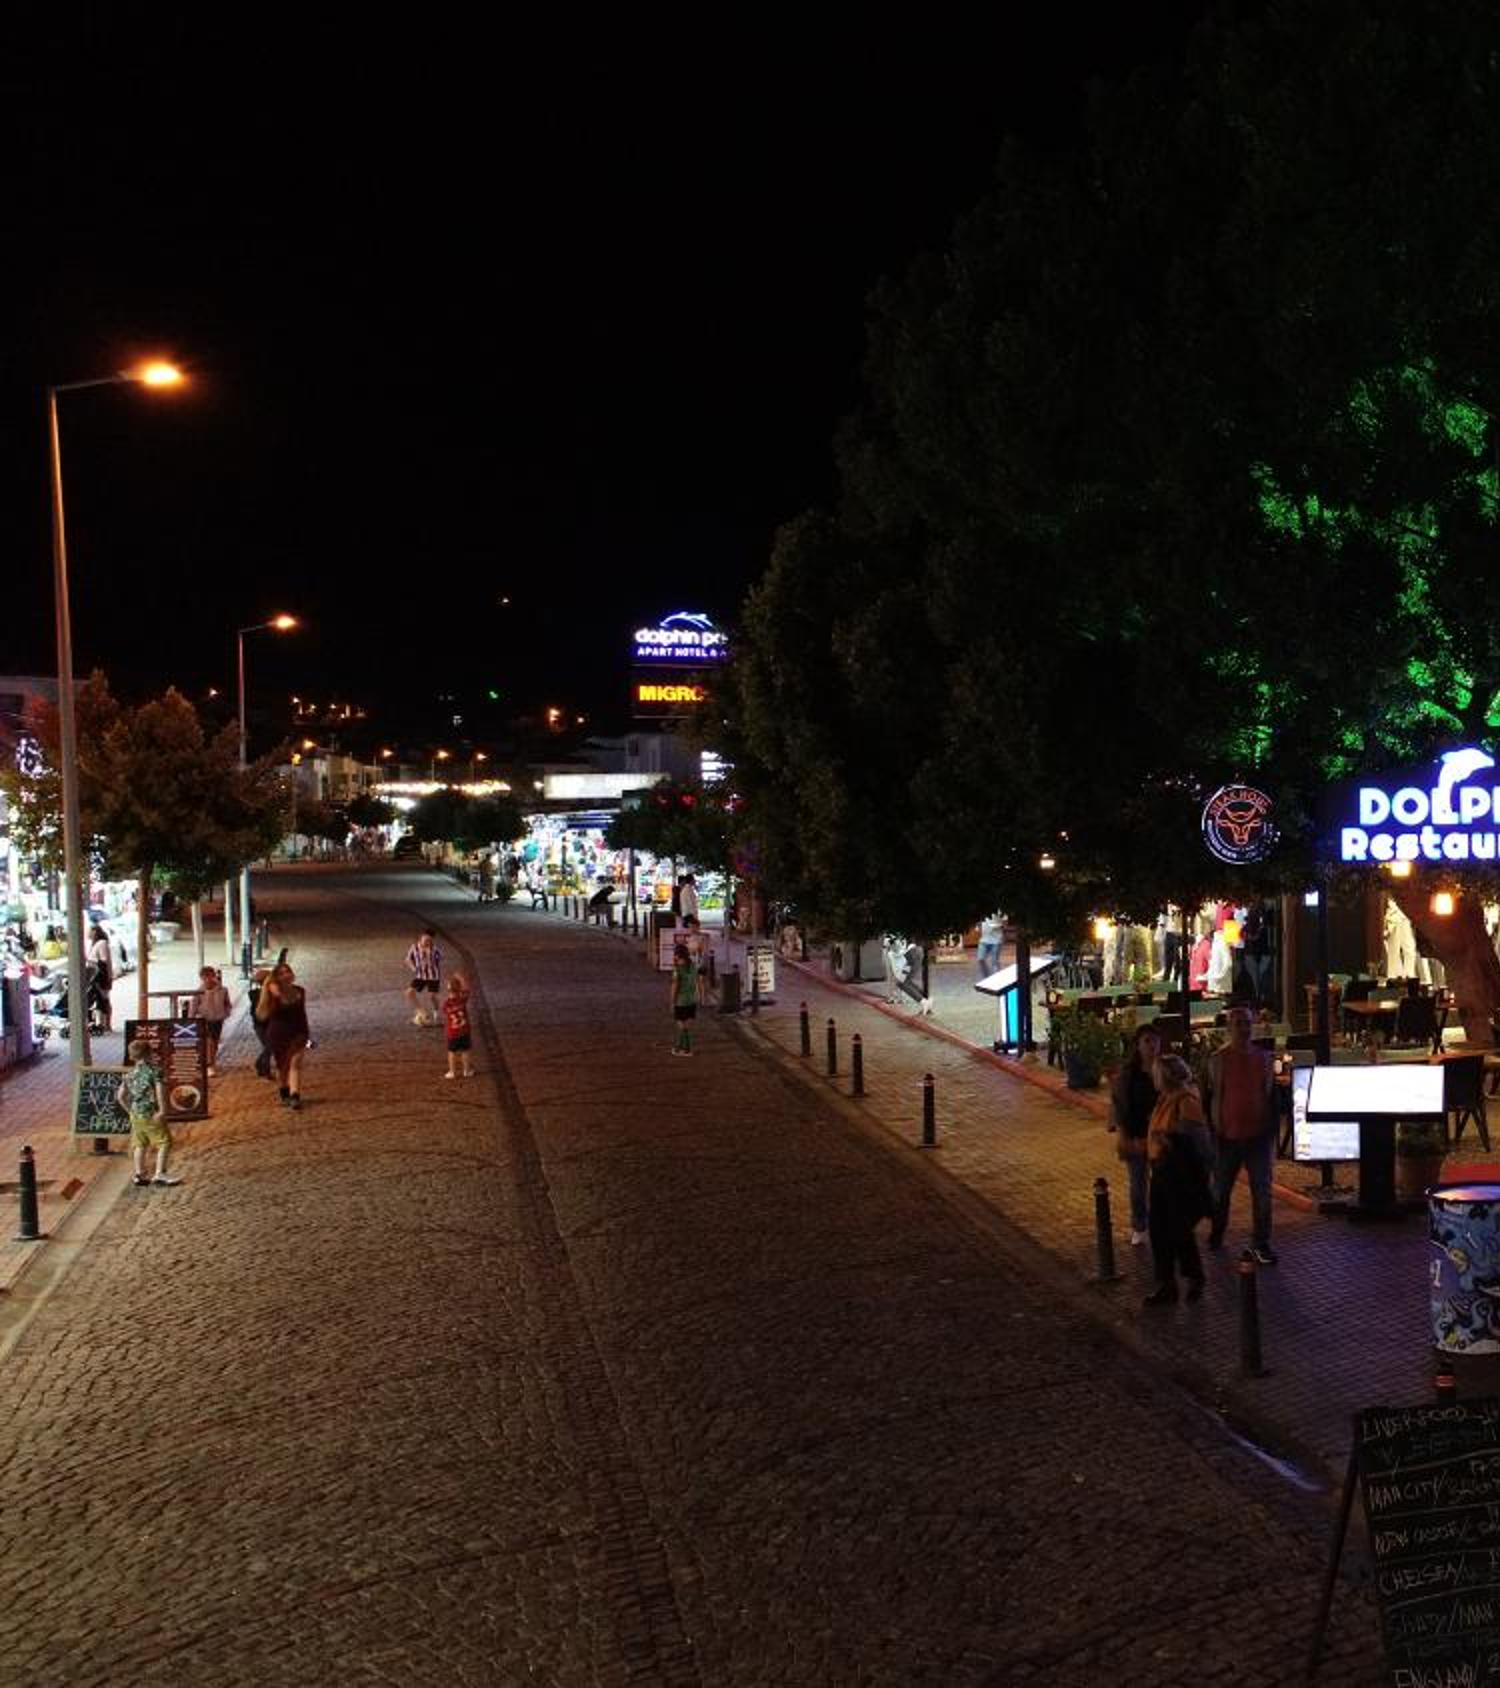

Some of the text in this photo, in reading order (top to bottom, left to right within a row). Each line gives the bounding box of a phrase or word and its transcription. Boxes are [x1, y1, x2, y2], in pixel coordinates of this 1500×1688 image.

[634, 627, 701, 647] dolphin
[637, 646, 673, 657] APART
[675, 646, 709, 657] HOTEL
